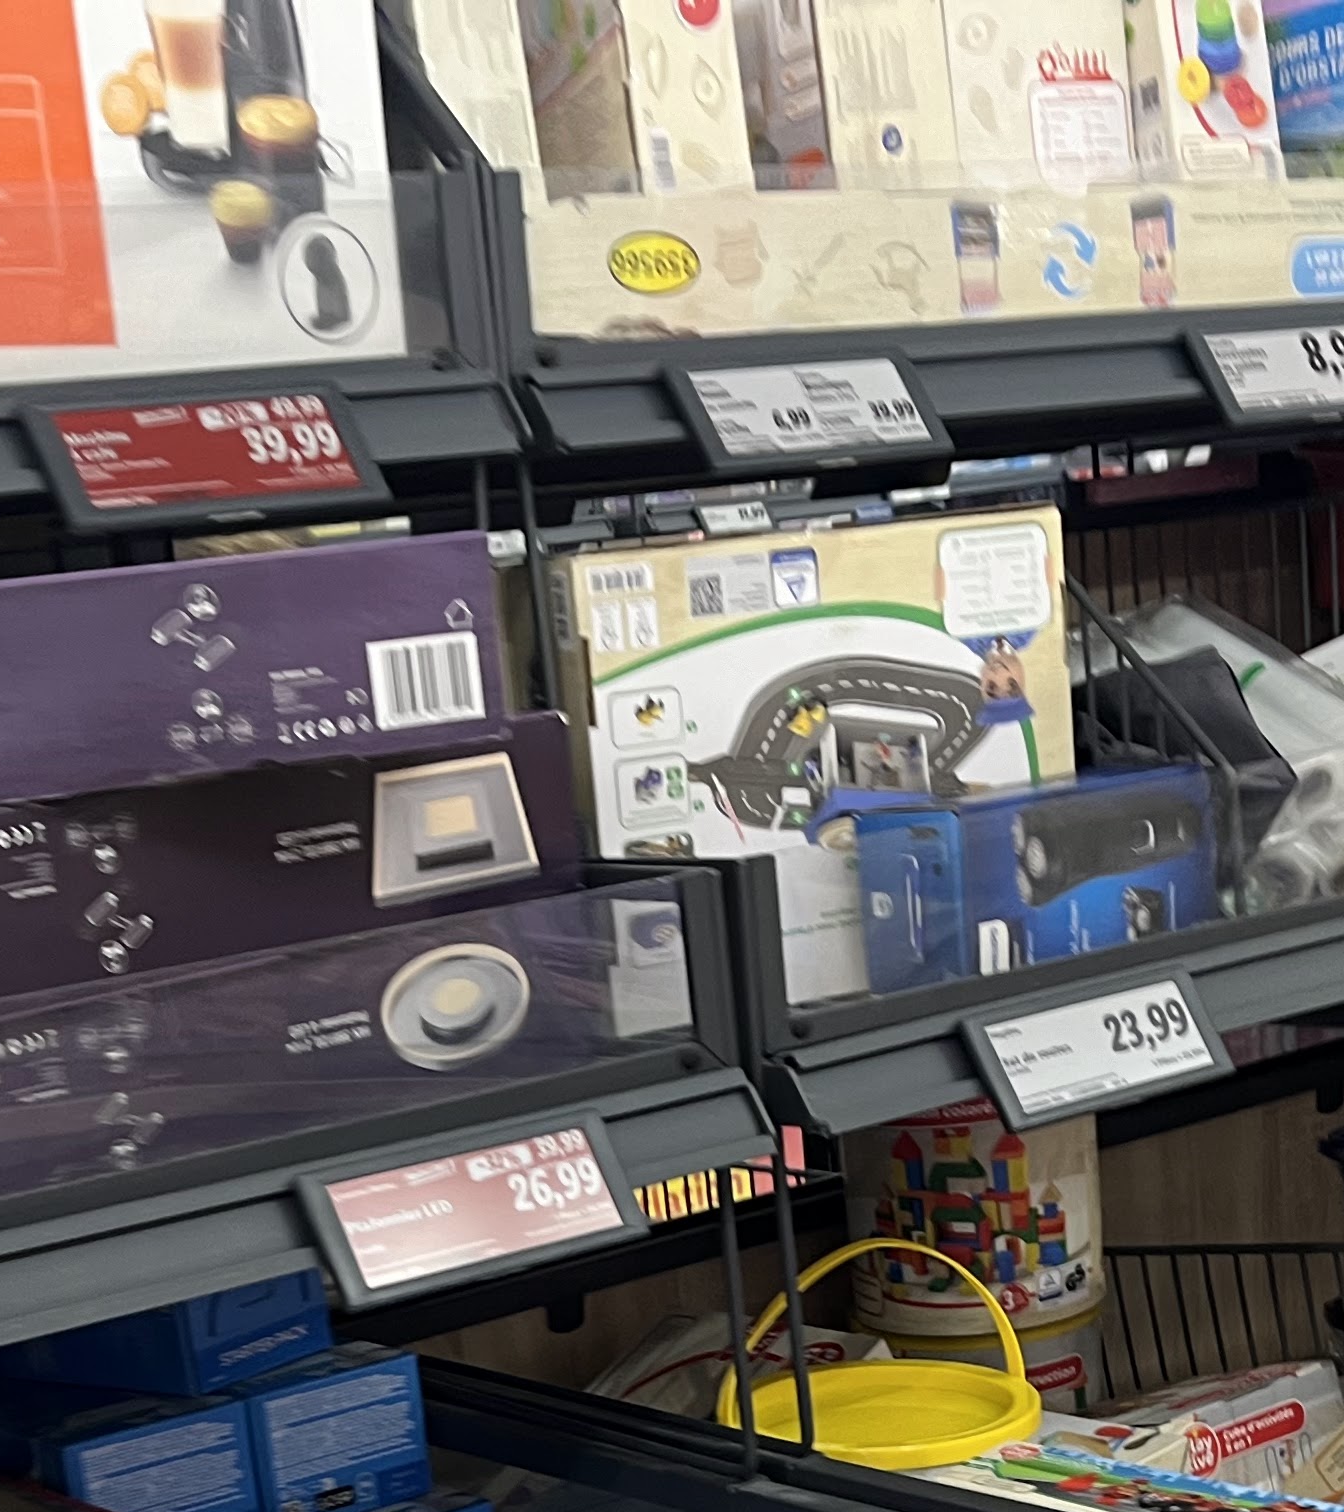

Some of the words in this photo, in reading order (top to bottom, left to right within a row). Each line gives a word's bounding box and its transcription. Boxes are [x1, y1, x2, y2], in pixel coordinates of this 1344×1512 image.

[240, 419, 342, 467] 39,99
[1102, 997, 1190, 1054] 23,99
[506, 1155, 604, 1214] 26,99
